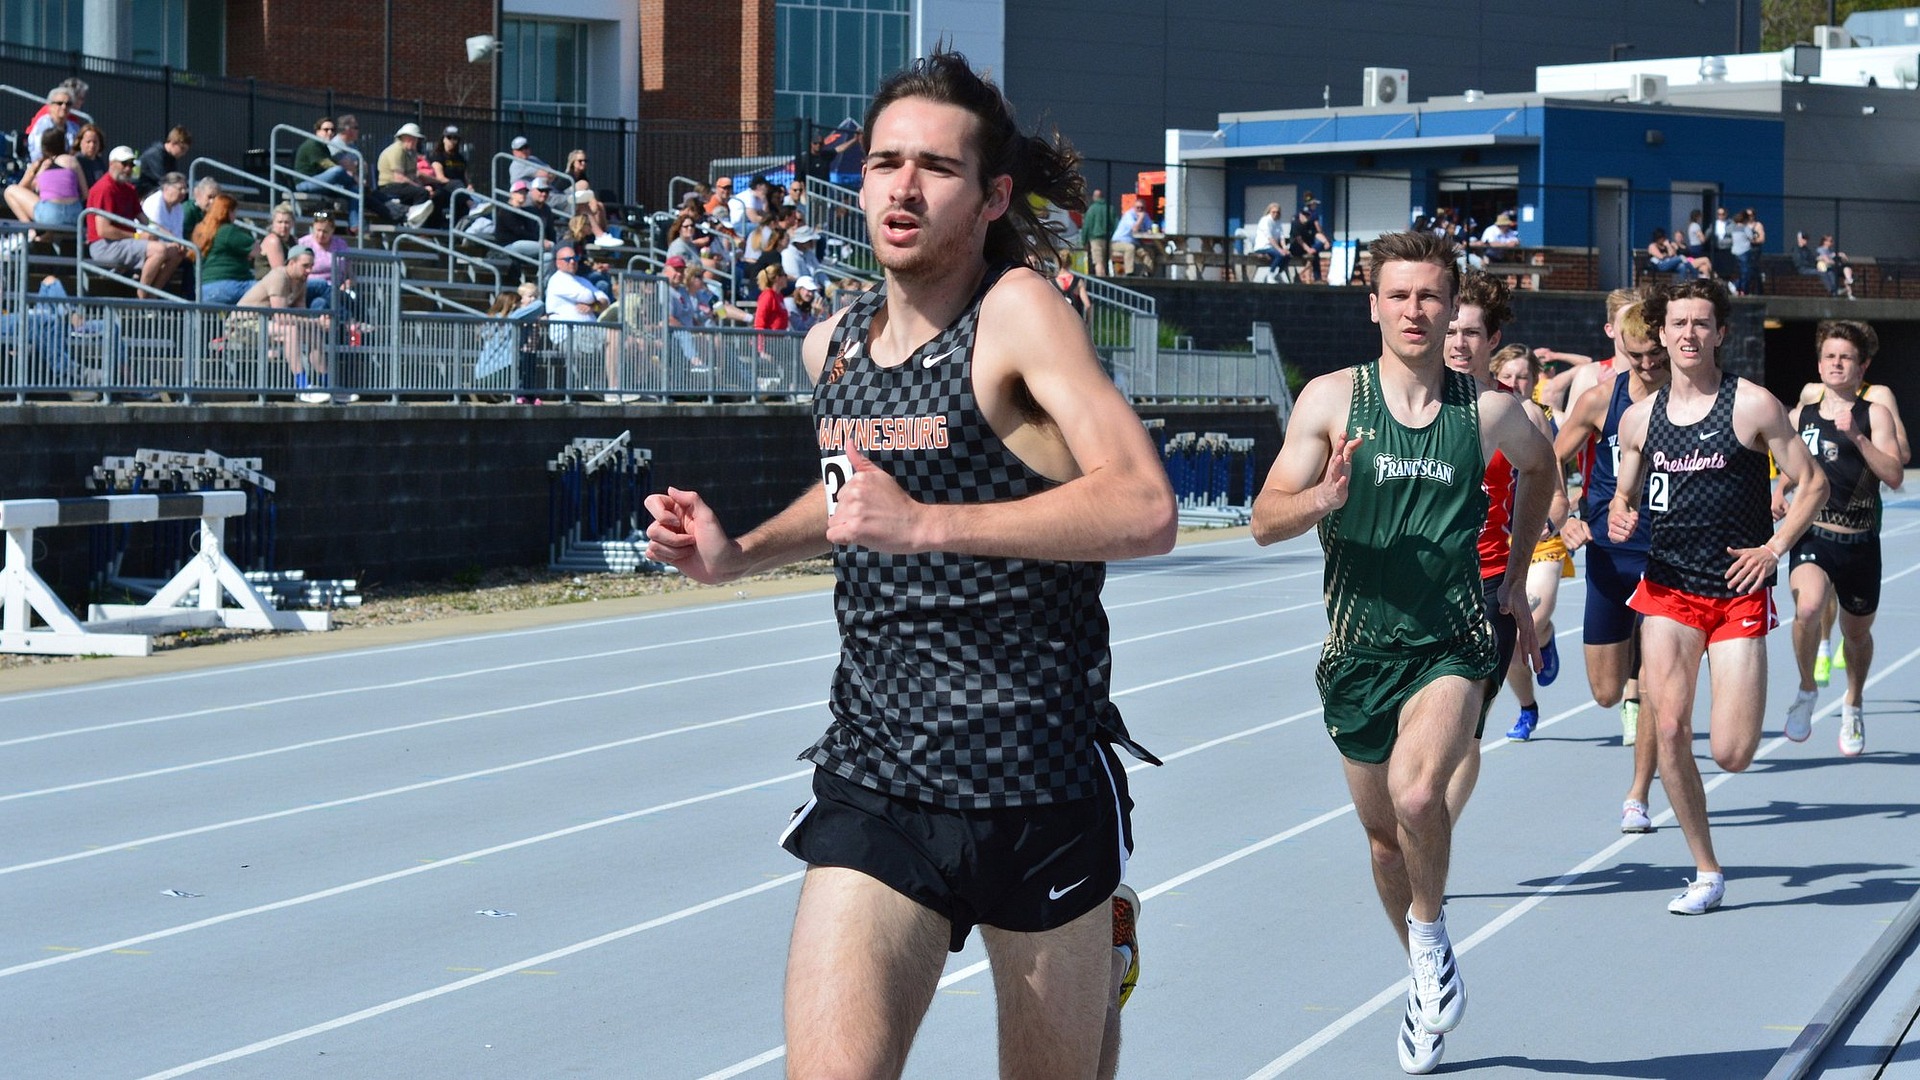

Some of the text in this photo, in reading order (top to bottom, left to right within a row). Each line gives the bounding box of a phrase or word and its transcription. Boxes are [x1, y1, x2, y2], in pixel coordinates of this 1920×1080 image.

[820, 416, 949, 450] WAYNESBURG
[1653, 448, 1727, 473] Presidents
[1651, 475, 1664, 508] 2
